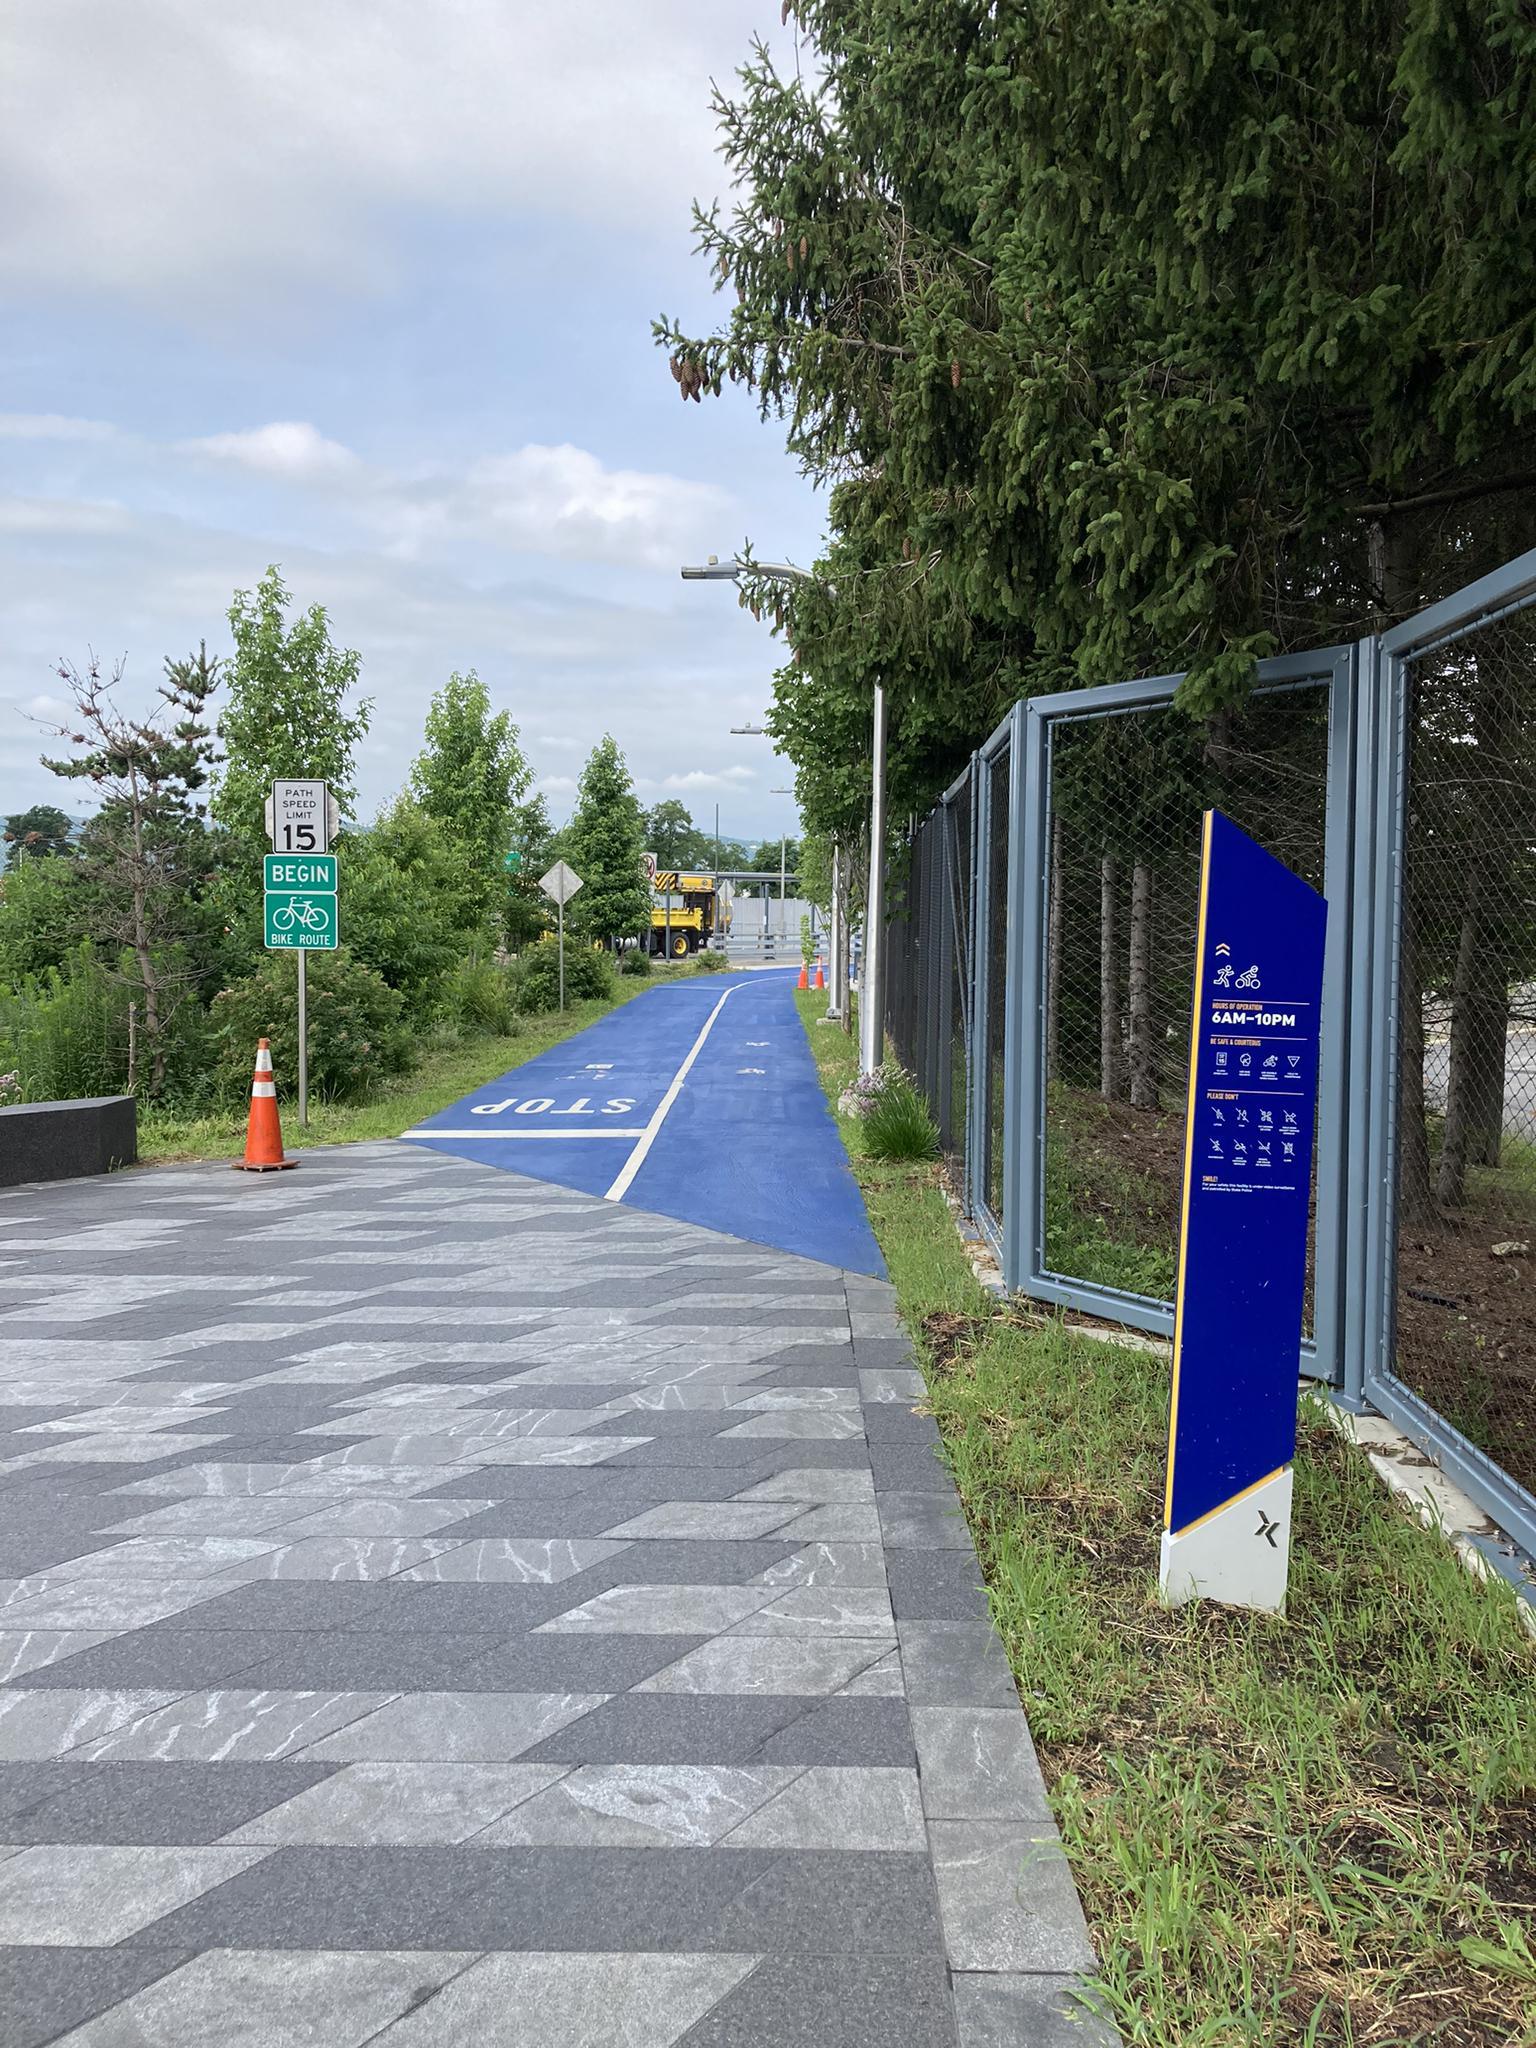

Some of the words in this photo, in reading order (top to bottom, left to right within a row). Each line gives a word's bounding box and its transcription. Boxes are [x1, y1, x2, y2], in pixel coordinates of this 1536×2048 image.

[285, 789, 313, 797] PATH
[282, 800, 317, 808] SPEED
[286, 811, 313, 819] LIMIT
[283, 824, 316, 851] 15
[272, 864, 329, 883] BEGIN
[271, 933, 293, 945] BIKE
[299, 934, 331, 946] ROUTE
[1212, 1002, 1229, 1010] HOURS
[1236, 1003, 1263, 1011] OPERATION
[1217, 1038, 1229, 1046] SAFE
[1234, 1039, 1262, 1047] COURTEOUS
[1206, 1092, 1224, 1100] PLEASE
[470, 1098, 637, 1114] STOP
